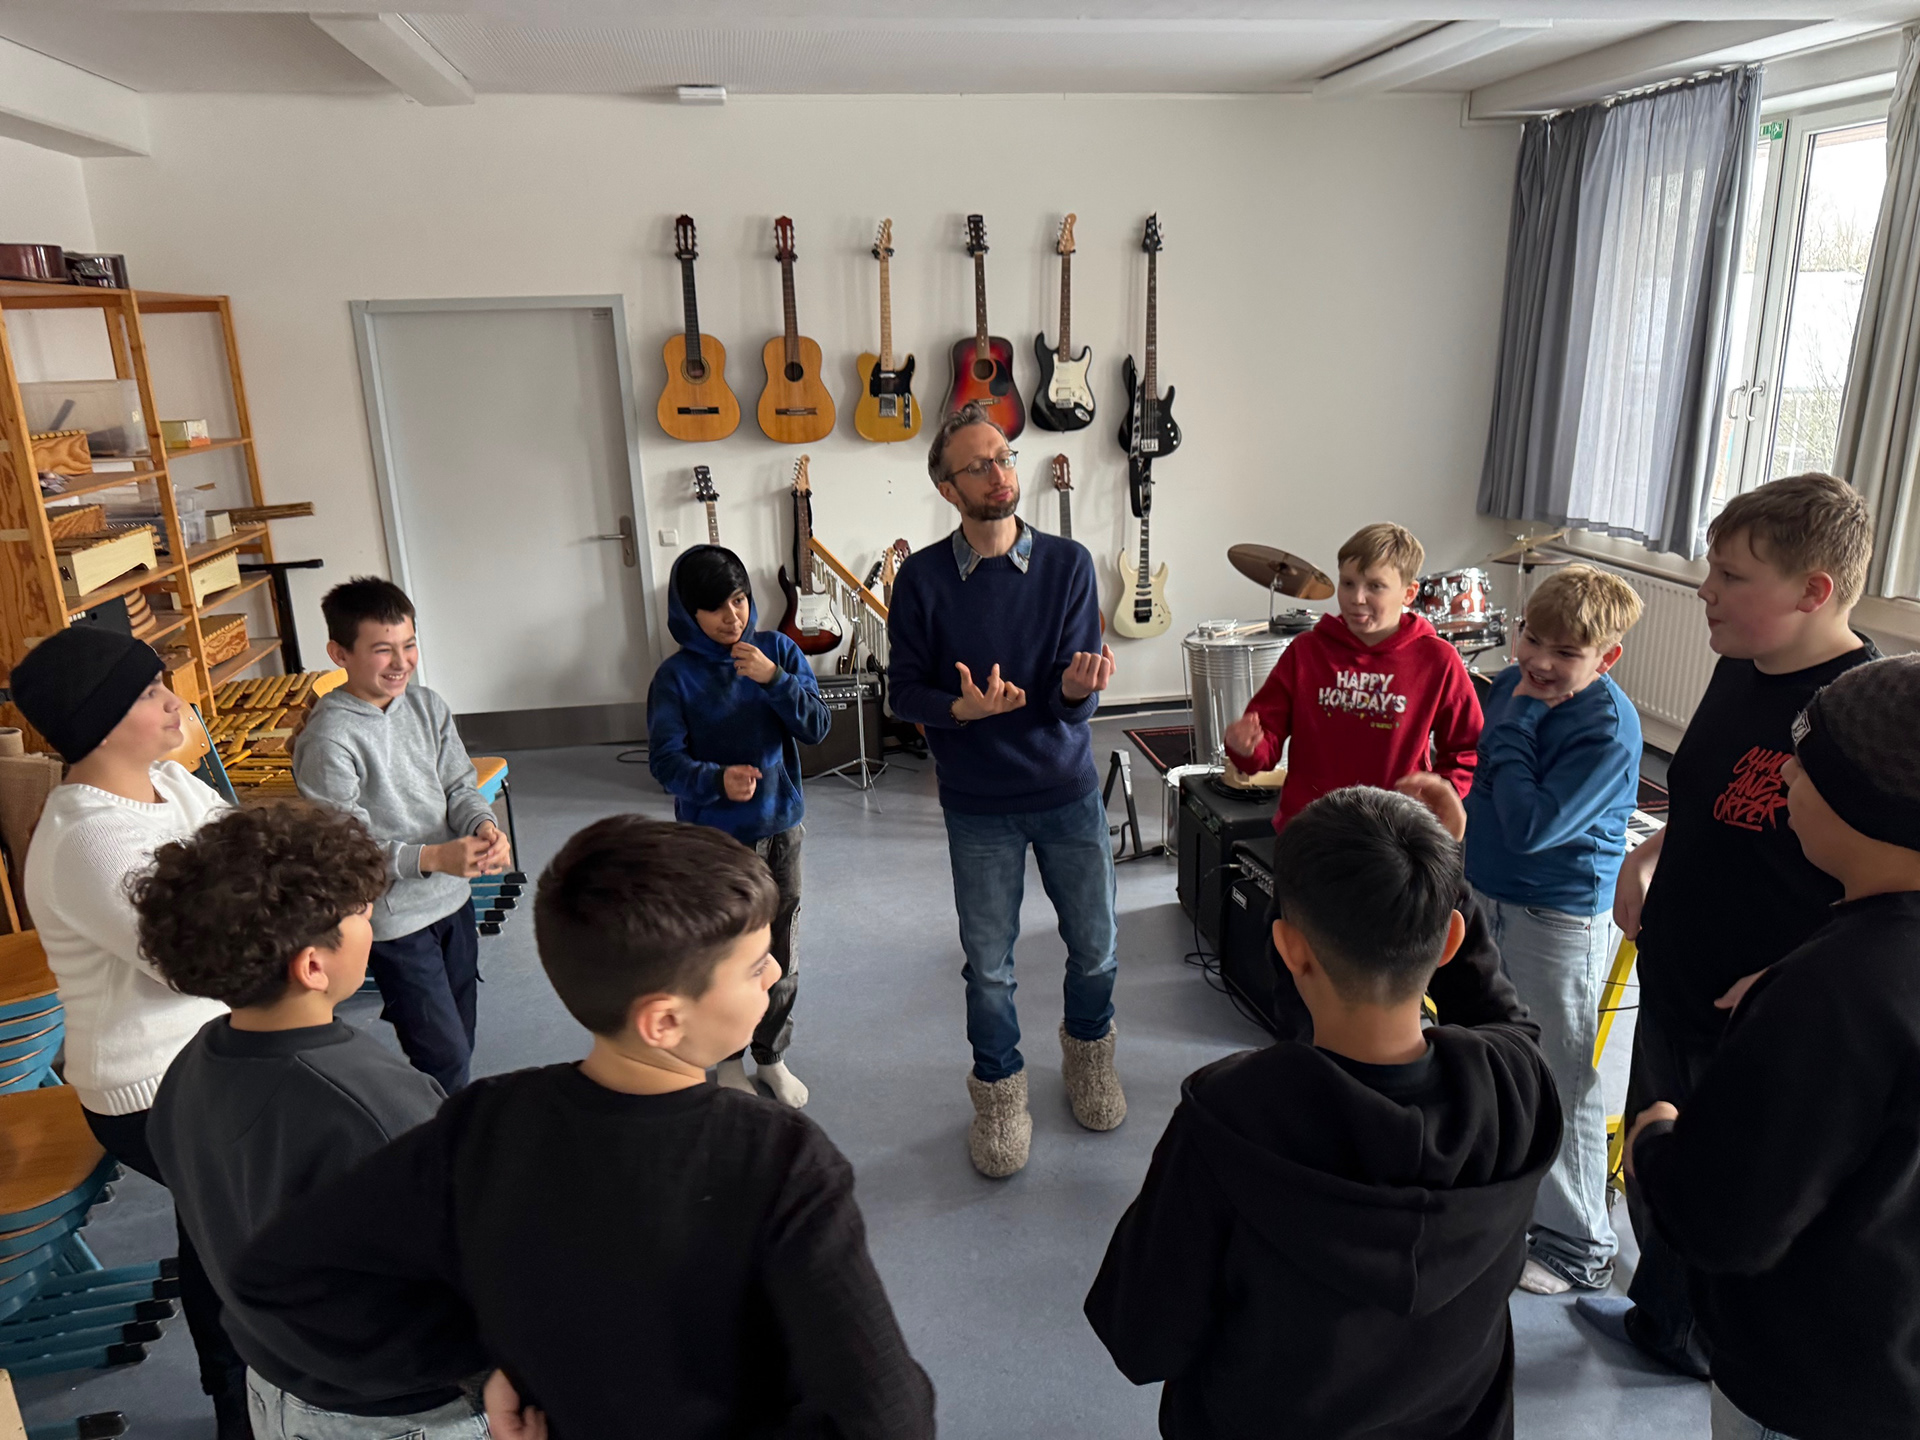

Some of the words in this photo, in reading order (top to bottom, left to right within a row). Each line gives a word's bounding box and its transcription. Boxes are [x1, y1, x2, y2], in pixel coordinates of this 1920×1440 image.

[1337, 670, 1394, 692] HAPPY
[1318, 687, 1407, 713] HOLIDAY'S
[1733, 746, 1793, 778] CHAO
[1725, 771, 1782, 799] AND
[1713, 792, 1788, 829] ORDER
